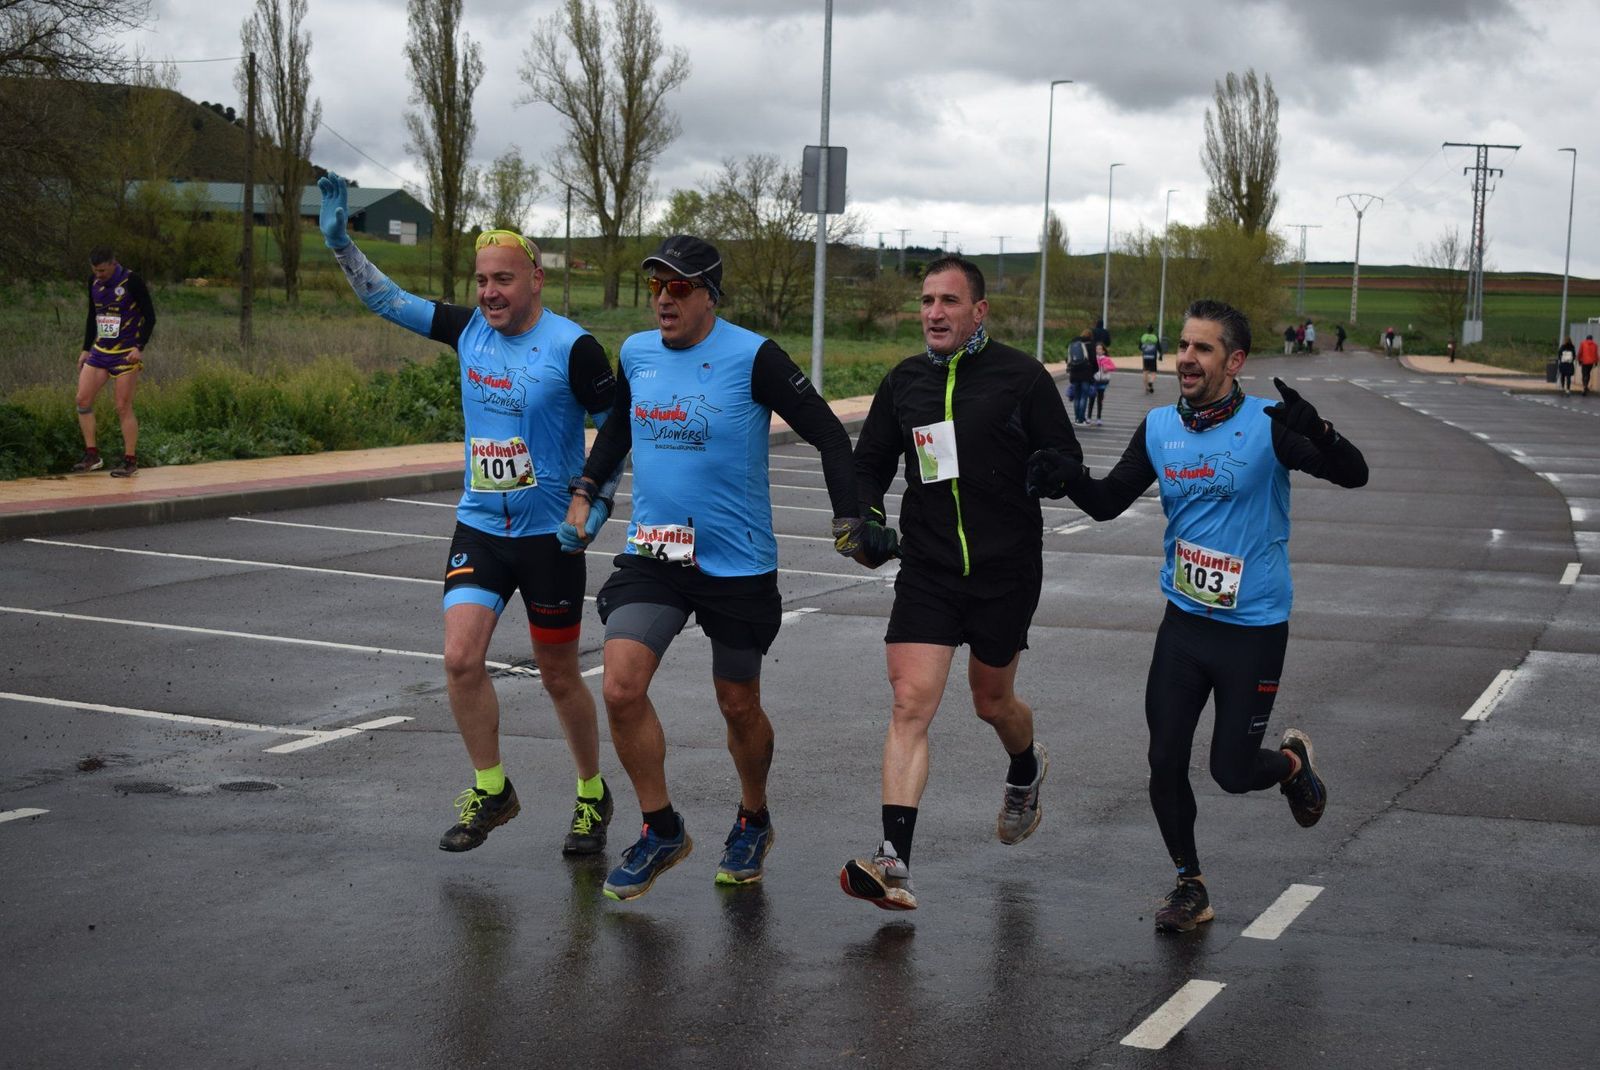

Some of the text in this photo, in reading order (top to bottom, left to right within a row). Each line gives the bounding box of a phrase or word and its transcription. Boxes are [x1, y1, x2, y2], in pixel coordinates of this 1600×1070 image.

[488, 393, 520, 409] FLOWERS
[658, 426, 702, 441] FLOWERS
[472, 442, 528, 457] bedunia
[480, 458, 517, 479] 101
[1176, 543, 1241, 574] bedunia
[1183, 563, 1224, 593] 103
